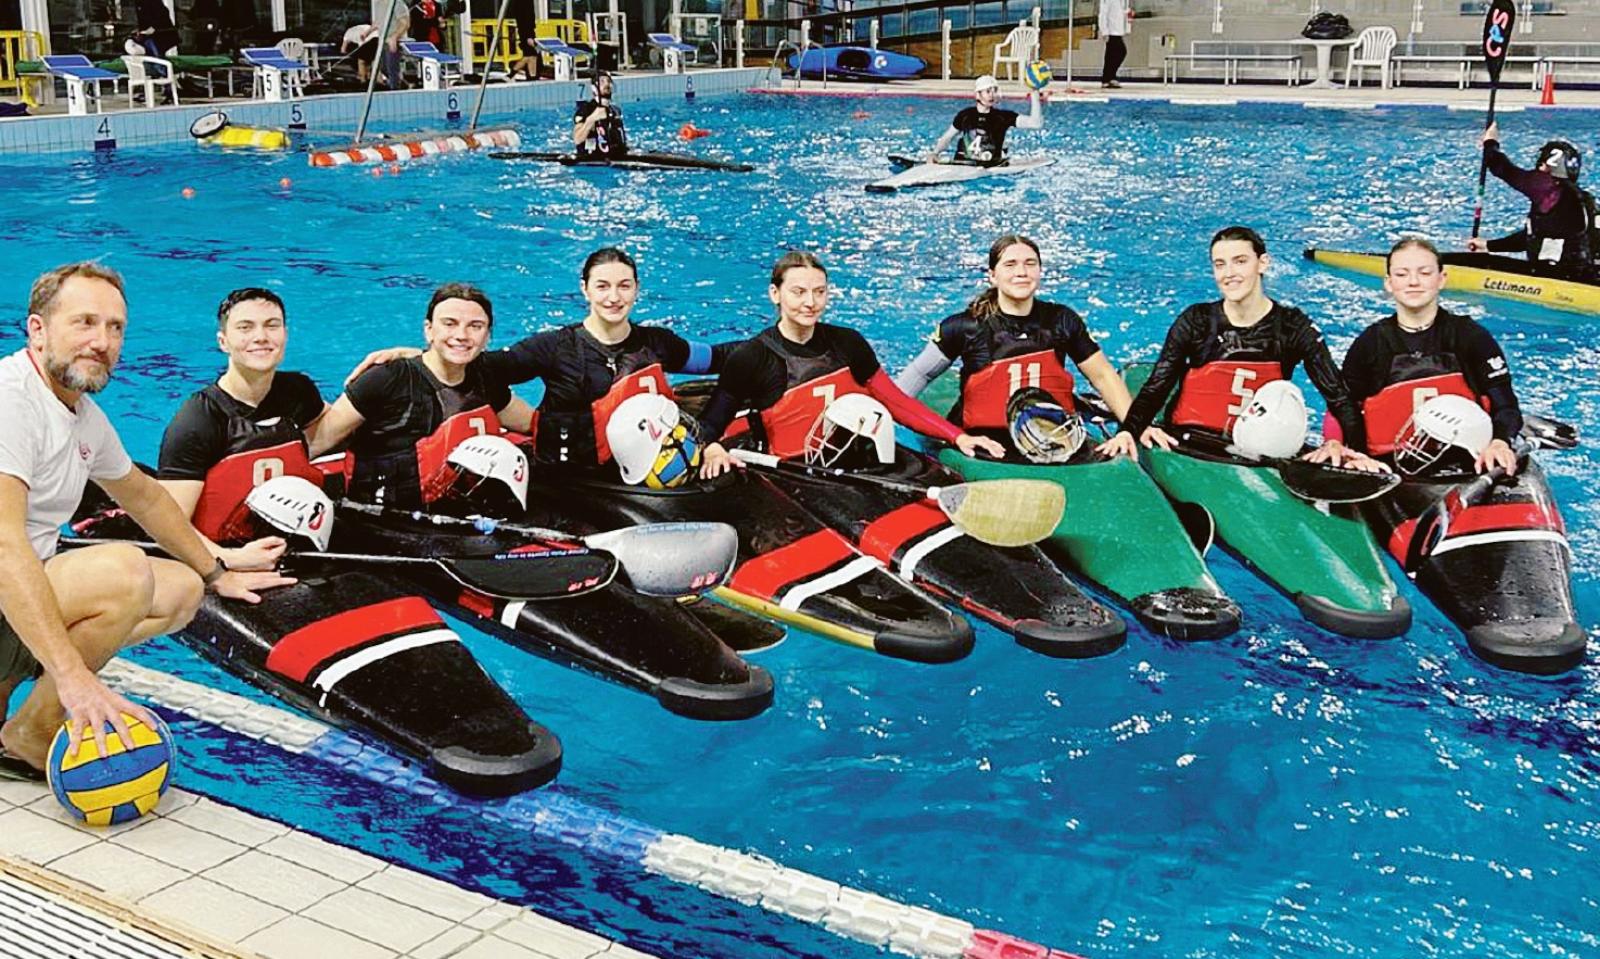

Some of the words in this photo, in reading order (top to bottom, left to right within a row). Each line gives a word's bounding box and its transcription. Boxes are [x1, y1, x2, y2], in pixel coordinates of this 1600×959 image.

[425, 65, 433, 82] 6
[557, 59, 562, 75] 7
[266, 73, 273, 92] 5
[578, 83, 586, 99] 7
[70, 84, 76, 105] 4
[448, 92, 458, 111] 6
[292, 104, 303, 123] 5
[97, 117, 111, 138] 4
[1546, 148, 1564, 167] 2
[1484, 278, 1541, 295] Lettmann
[1007, 362, 1041, 397] 11
[1227, 367, 1257, 416] 5
[871, 410, 883, 435] 7
